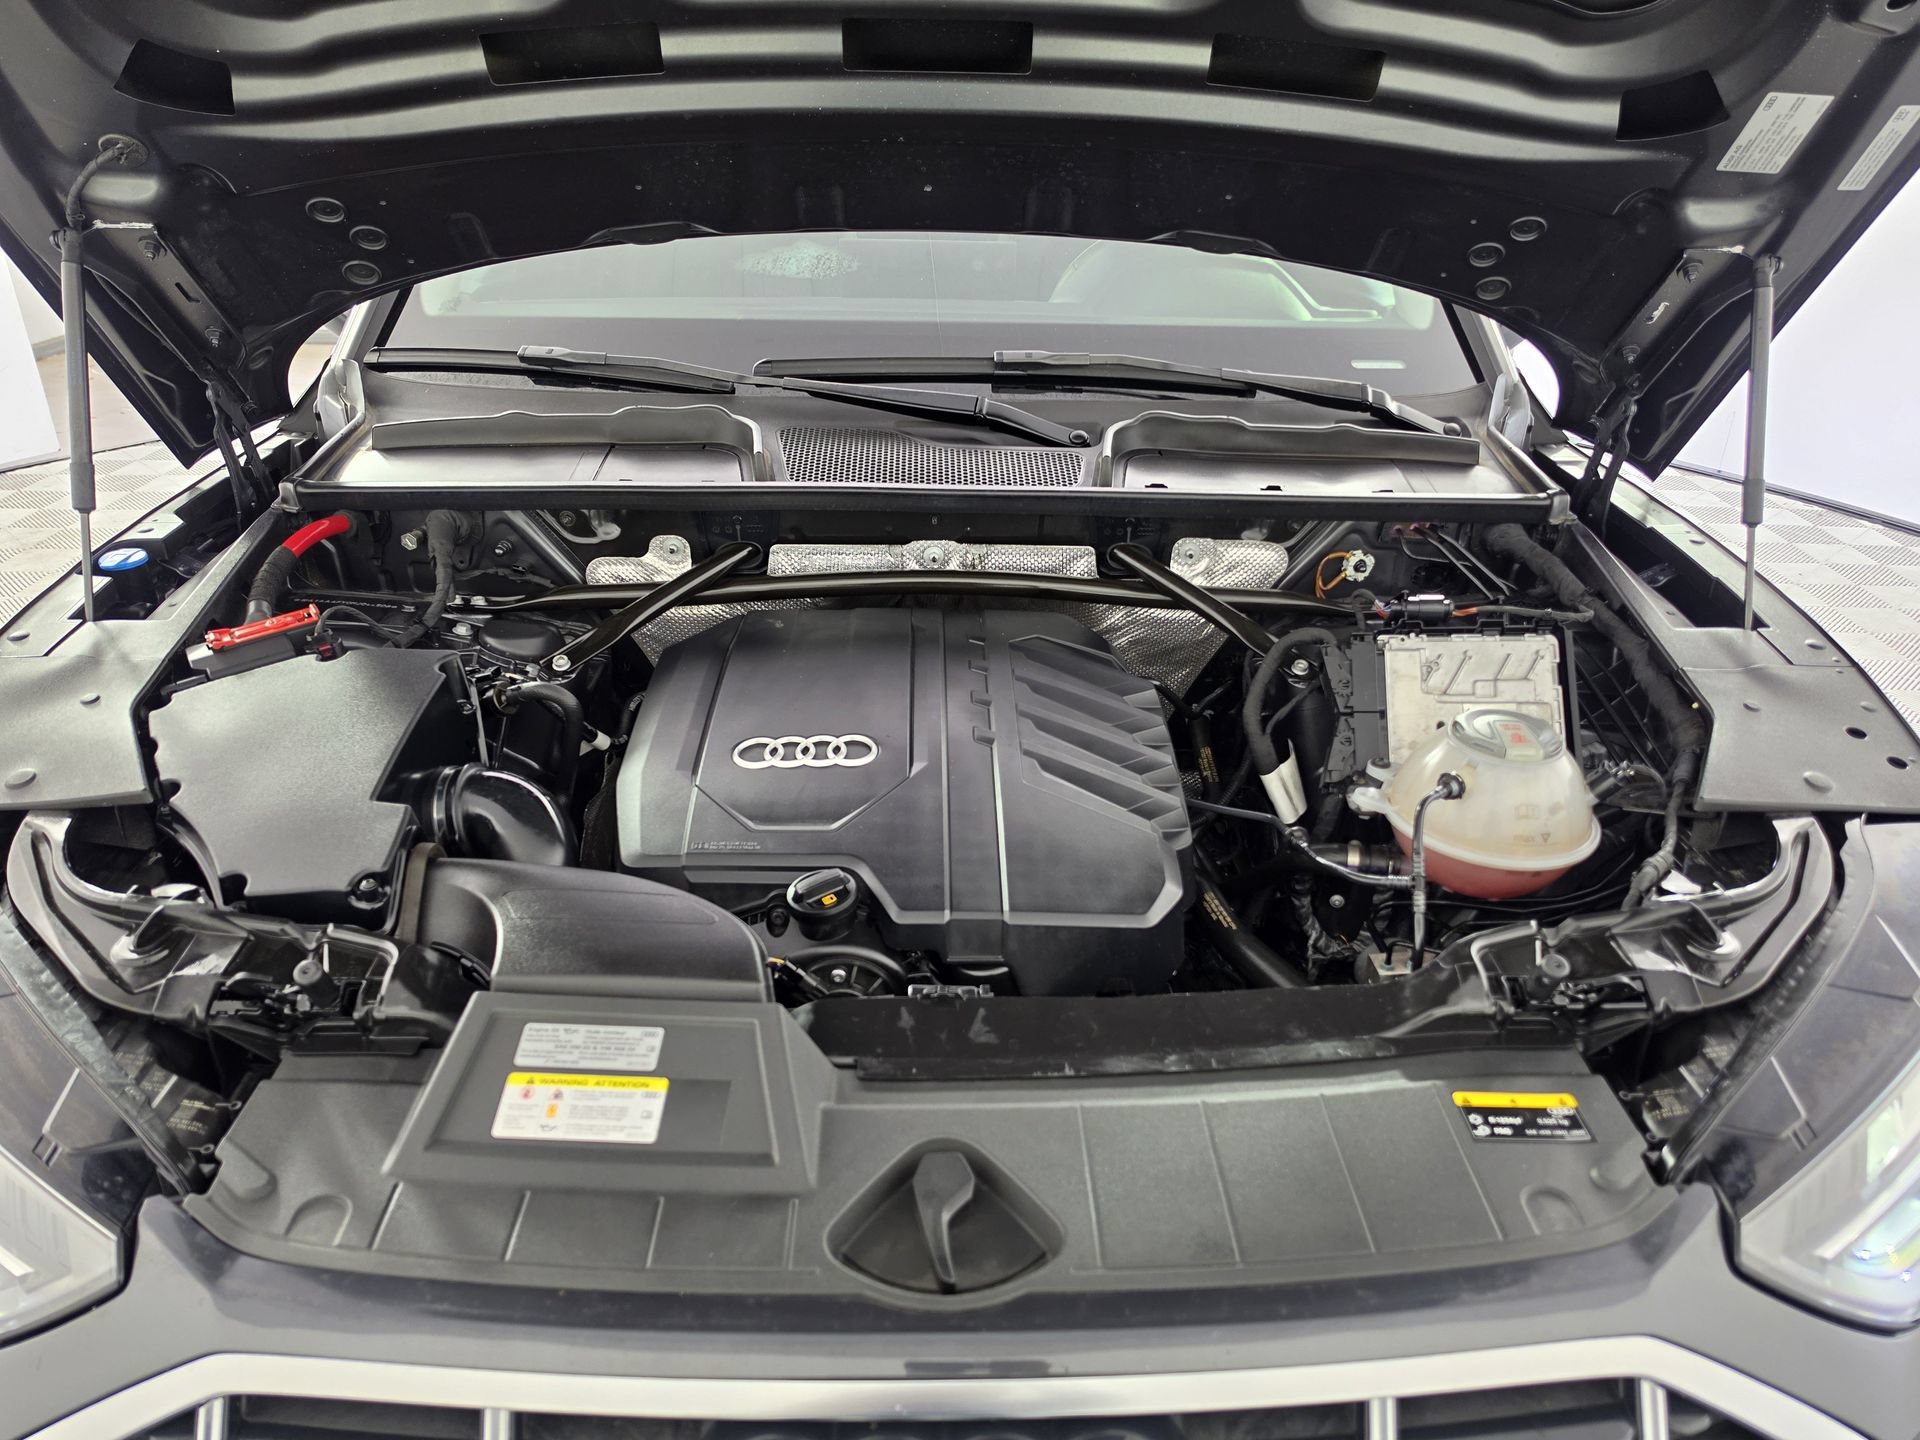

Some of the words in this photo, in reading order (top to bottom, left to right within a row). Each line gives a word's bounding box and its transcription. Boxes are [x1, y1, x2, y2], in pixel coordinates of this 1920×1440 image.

[1722, 154, 1734, 169] AUDI
[539, 1078, 589, 1087] WARNING
[593, 1079, 651, 1089] ATTENTION
